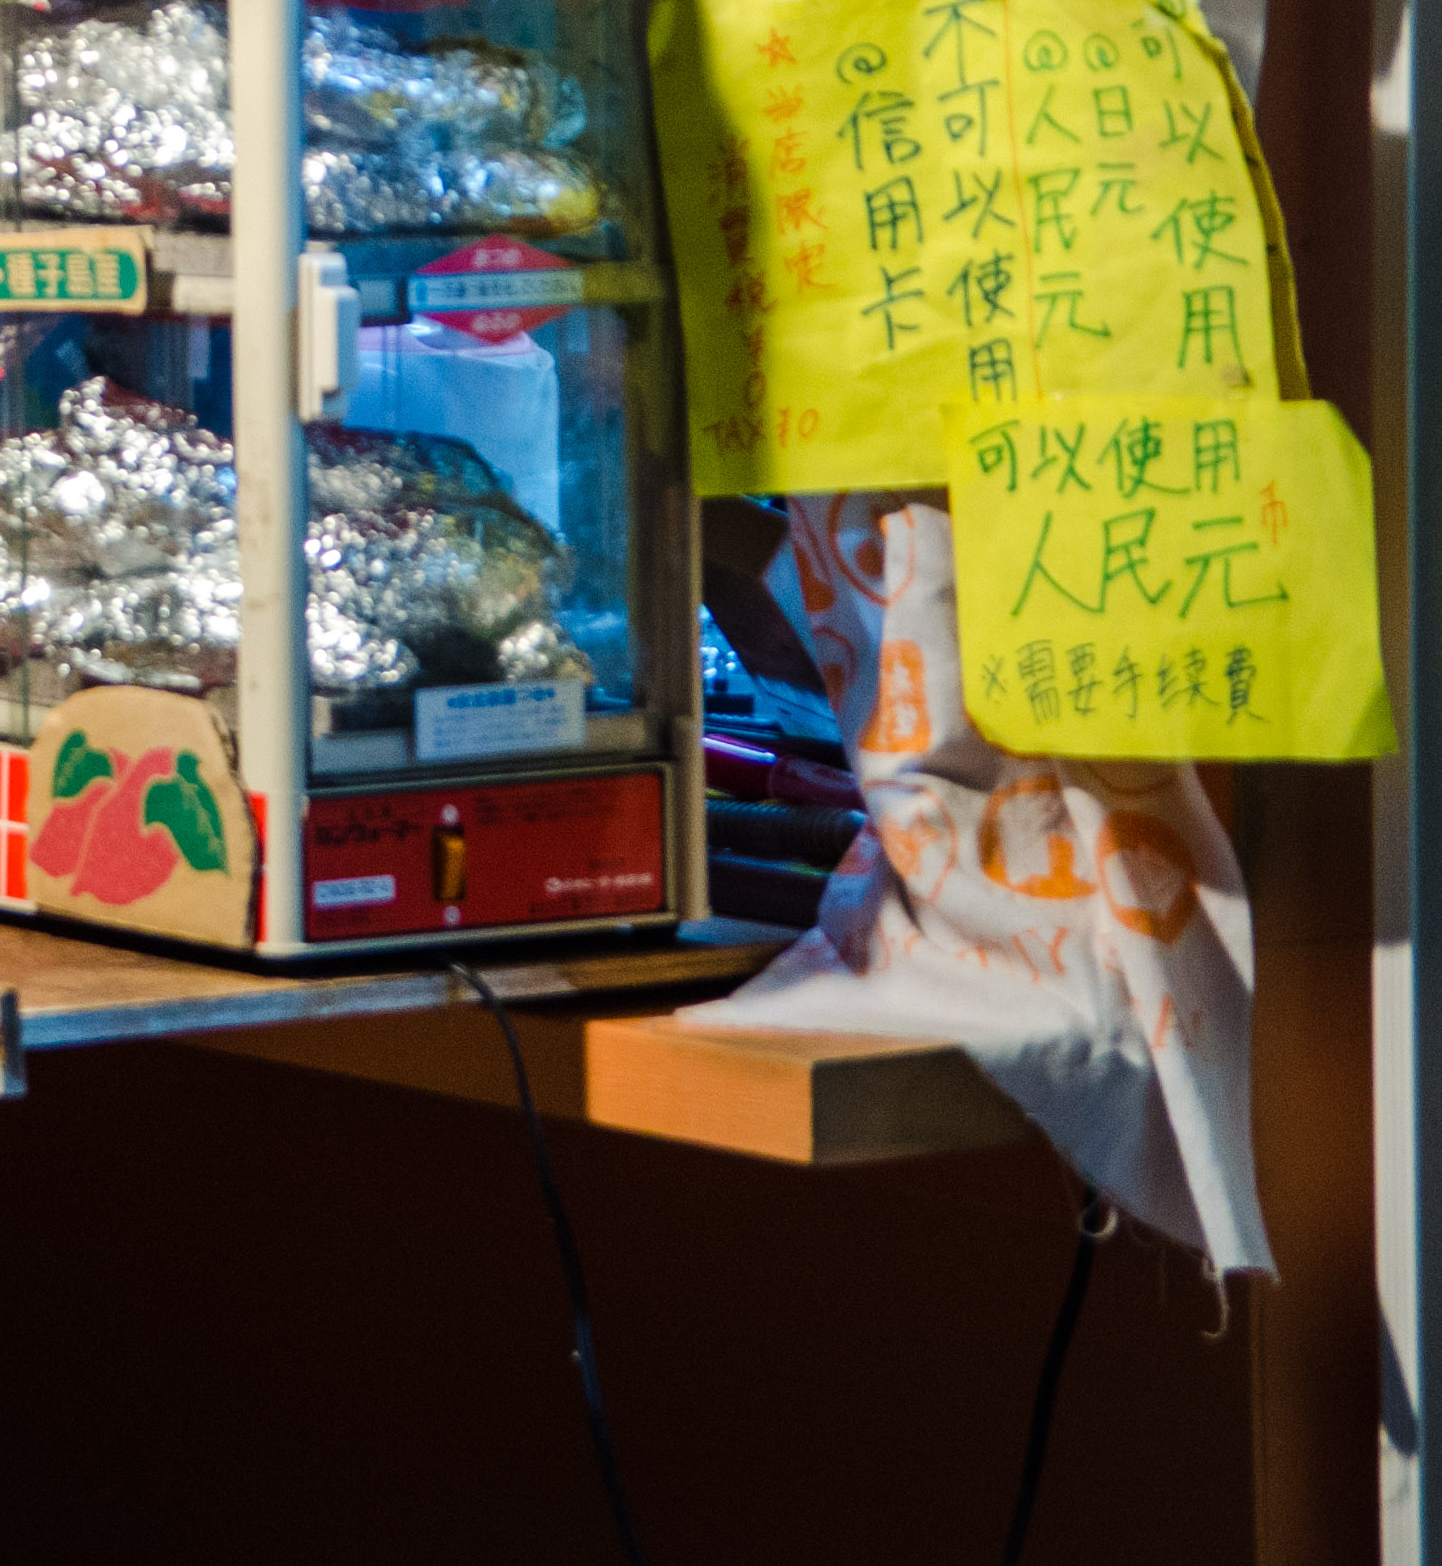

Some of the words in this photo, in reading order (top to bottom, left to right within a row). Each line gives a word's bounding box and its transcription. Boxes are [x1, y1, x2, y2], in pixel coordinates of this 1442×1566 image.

[971, 417, 1244, 495] 可以使用
[1012, 505, 1291, 620] 人民元
